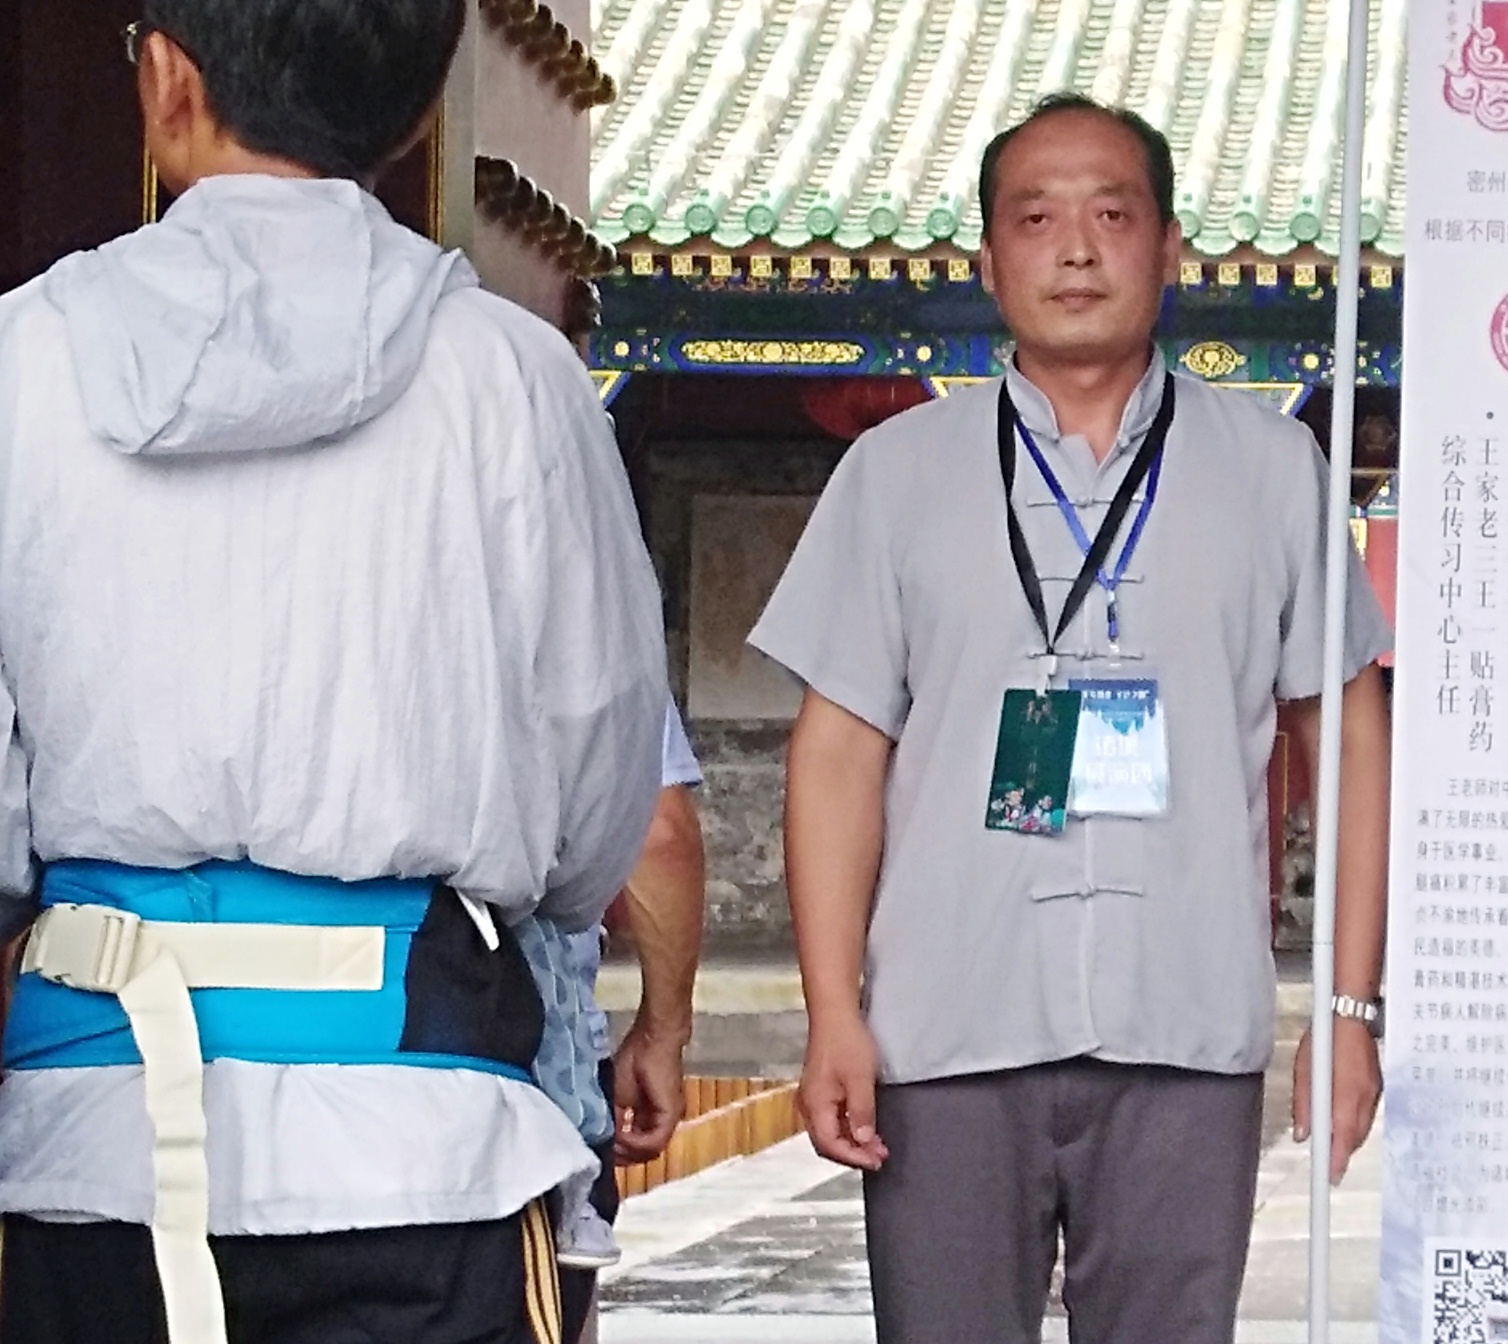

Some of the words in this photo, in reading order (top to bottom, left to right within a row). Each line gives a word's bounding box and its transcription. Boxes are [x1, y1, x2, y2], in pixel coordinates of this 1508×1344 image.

[1437, 434, 1466, 716] 综合传习中心主任
[1469, 437, 1500, 754] 王家老三王一贴膏药
